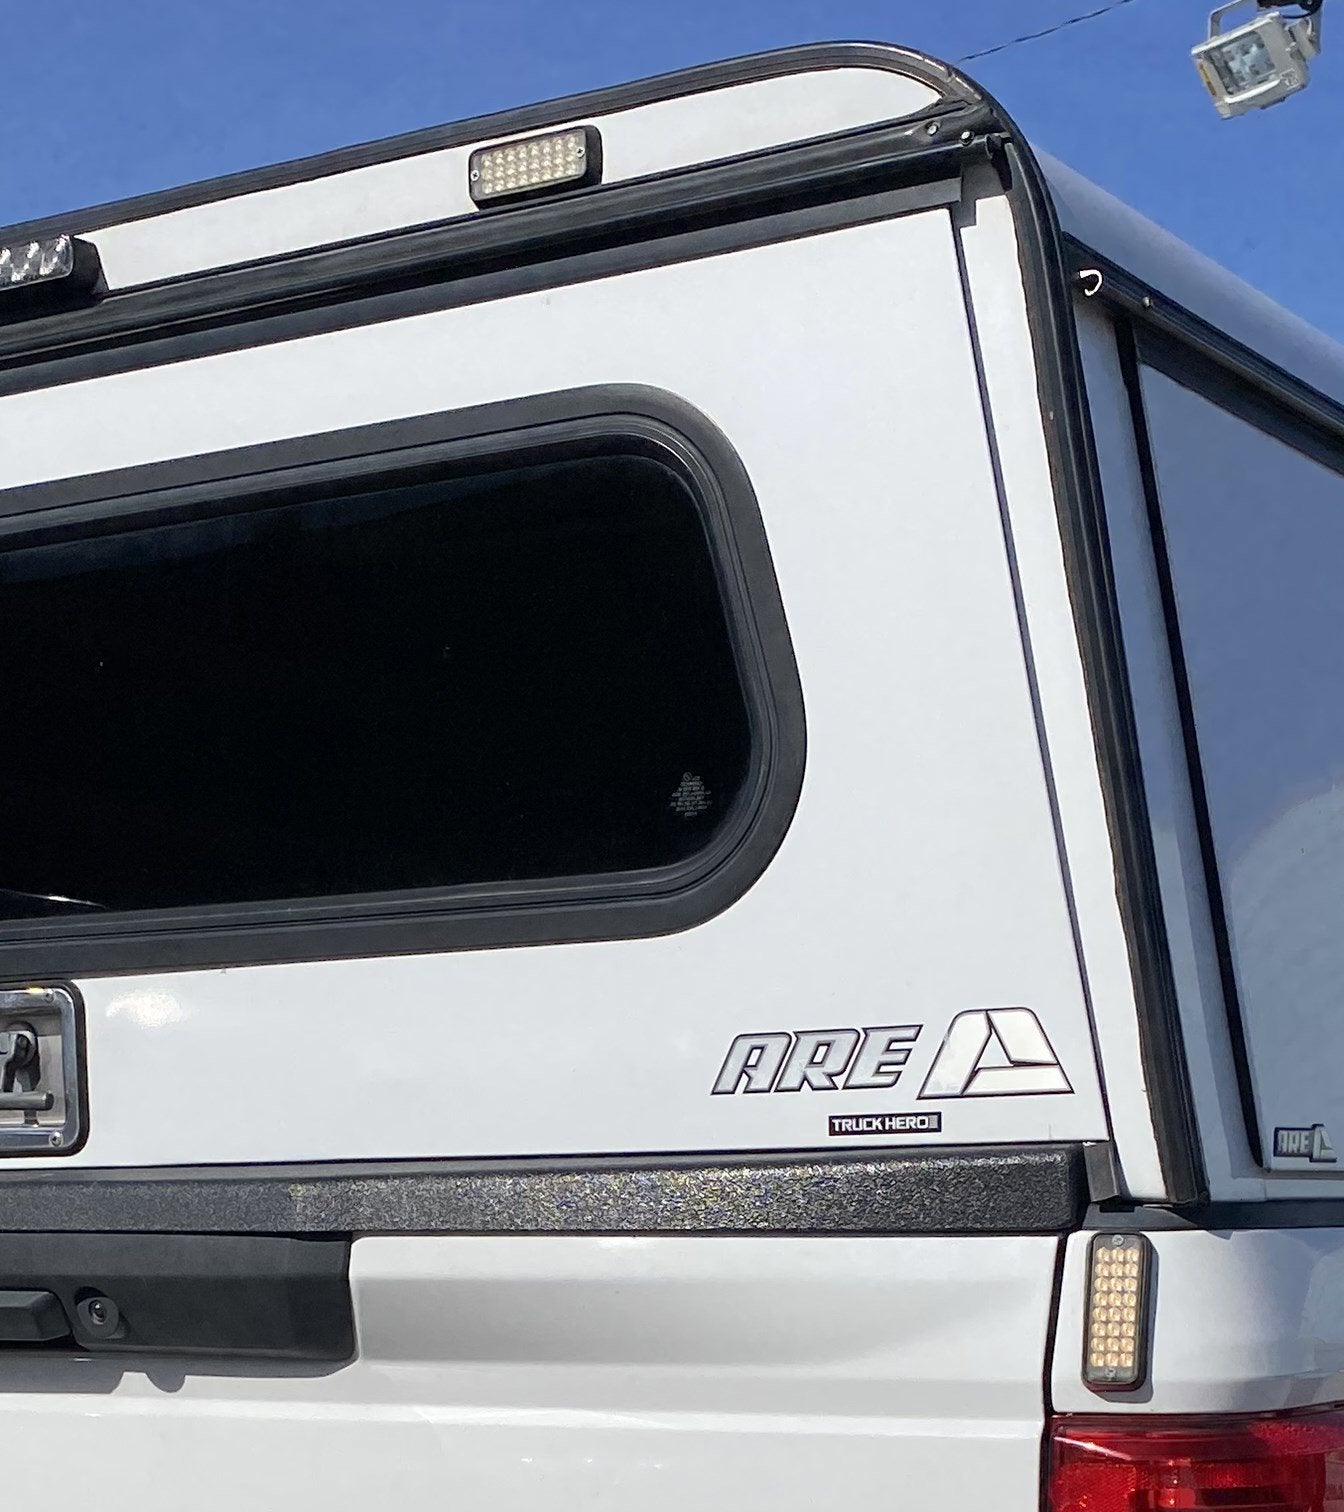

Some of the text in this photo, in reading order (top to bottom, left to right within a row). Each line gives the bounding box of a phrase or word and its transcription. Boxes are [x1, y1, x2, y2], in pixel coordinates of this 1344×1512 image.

[710, 1024, 923, 1095] ARE
[831, 1115, 929, 1132] TRUCK HERO
[1277, 1129, 1311, 1153] ARE
